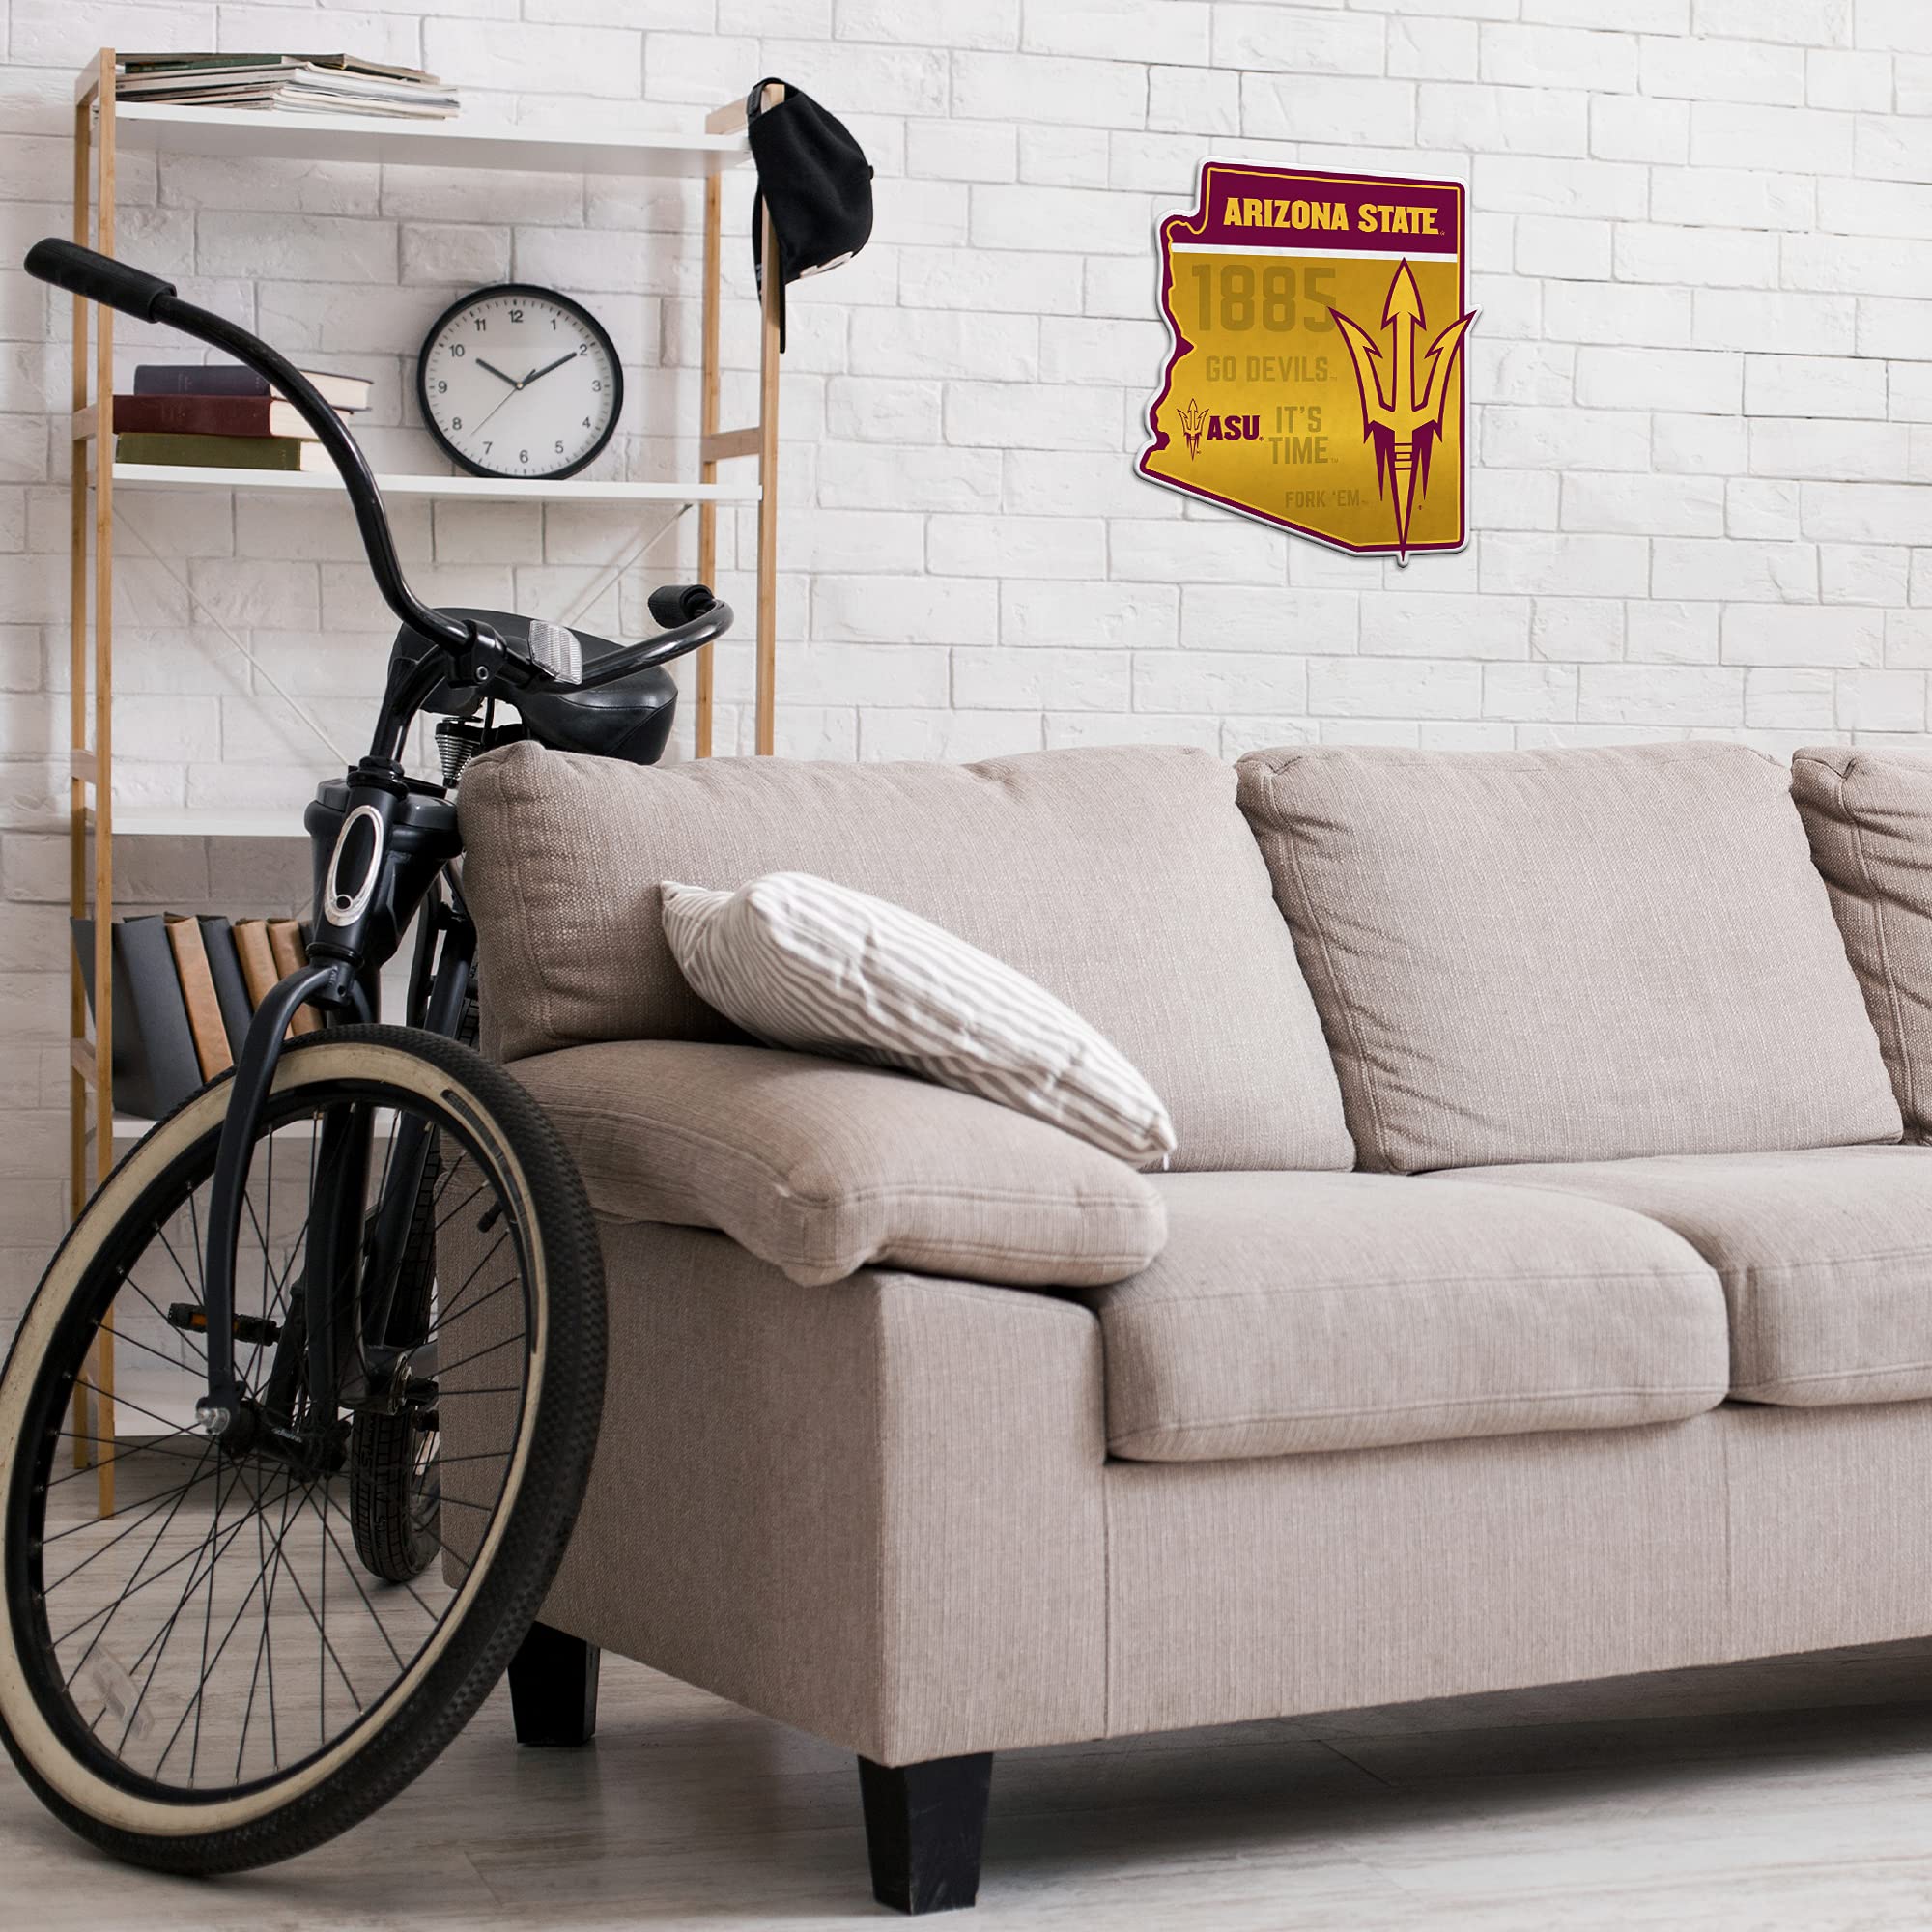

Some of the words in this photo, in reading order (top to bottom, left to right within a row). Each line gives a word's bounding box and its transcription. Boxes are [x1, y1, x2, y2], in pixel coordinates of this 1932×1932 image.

[1223, 196, 1350, 231] ARIZONA
[1357, 203, 1439, 235] STATE
[1191, 264, 1337, 333] 1885
[508, 309, 524, 324] 12
[474, 318, 487, 331] 11
[550, 318, 557, 331] 1
[449, 344, 466, 357] 10
[579, 343, 588, 357] 2
[1206, 355, 1236, 383] GO
[1246, 355, 1329, 383] DEVILS
[438, 380, 448, 394] 9
[591, 379, 602, 392] 3
[452, 416, 463, 431] 8
[582, 416, 592, 429] 4
[1275, 405, 1322, 434] IT'S
[1207, 414, 1262, 441] ASU
[482, 440, 494, 455] 7
[554, 440, 565, 455] 5
[1268, 436, 1330, 465] TIME
[518, 449, 529, 464] 6
[1285, 490, 1326, 509] FORK
